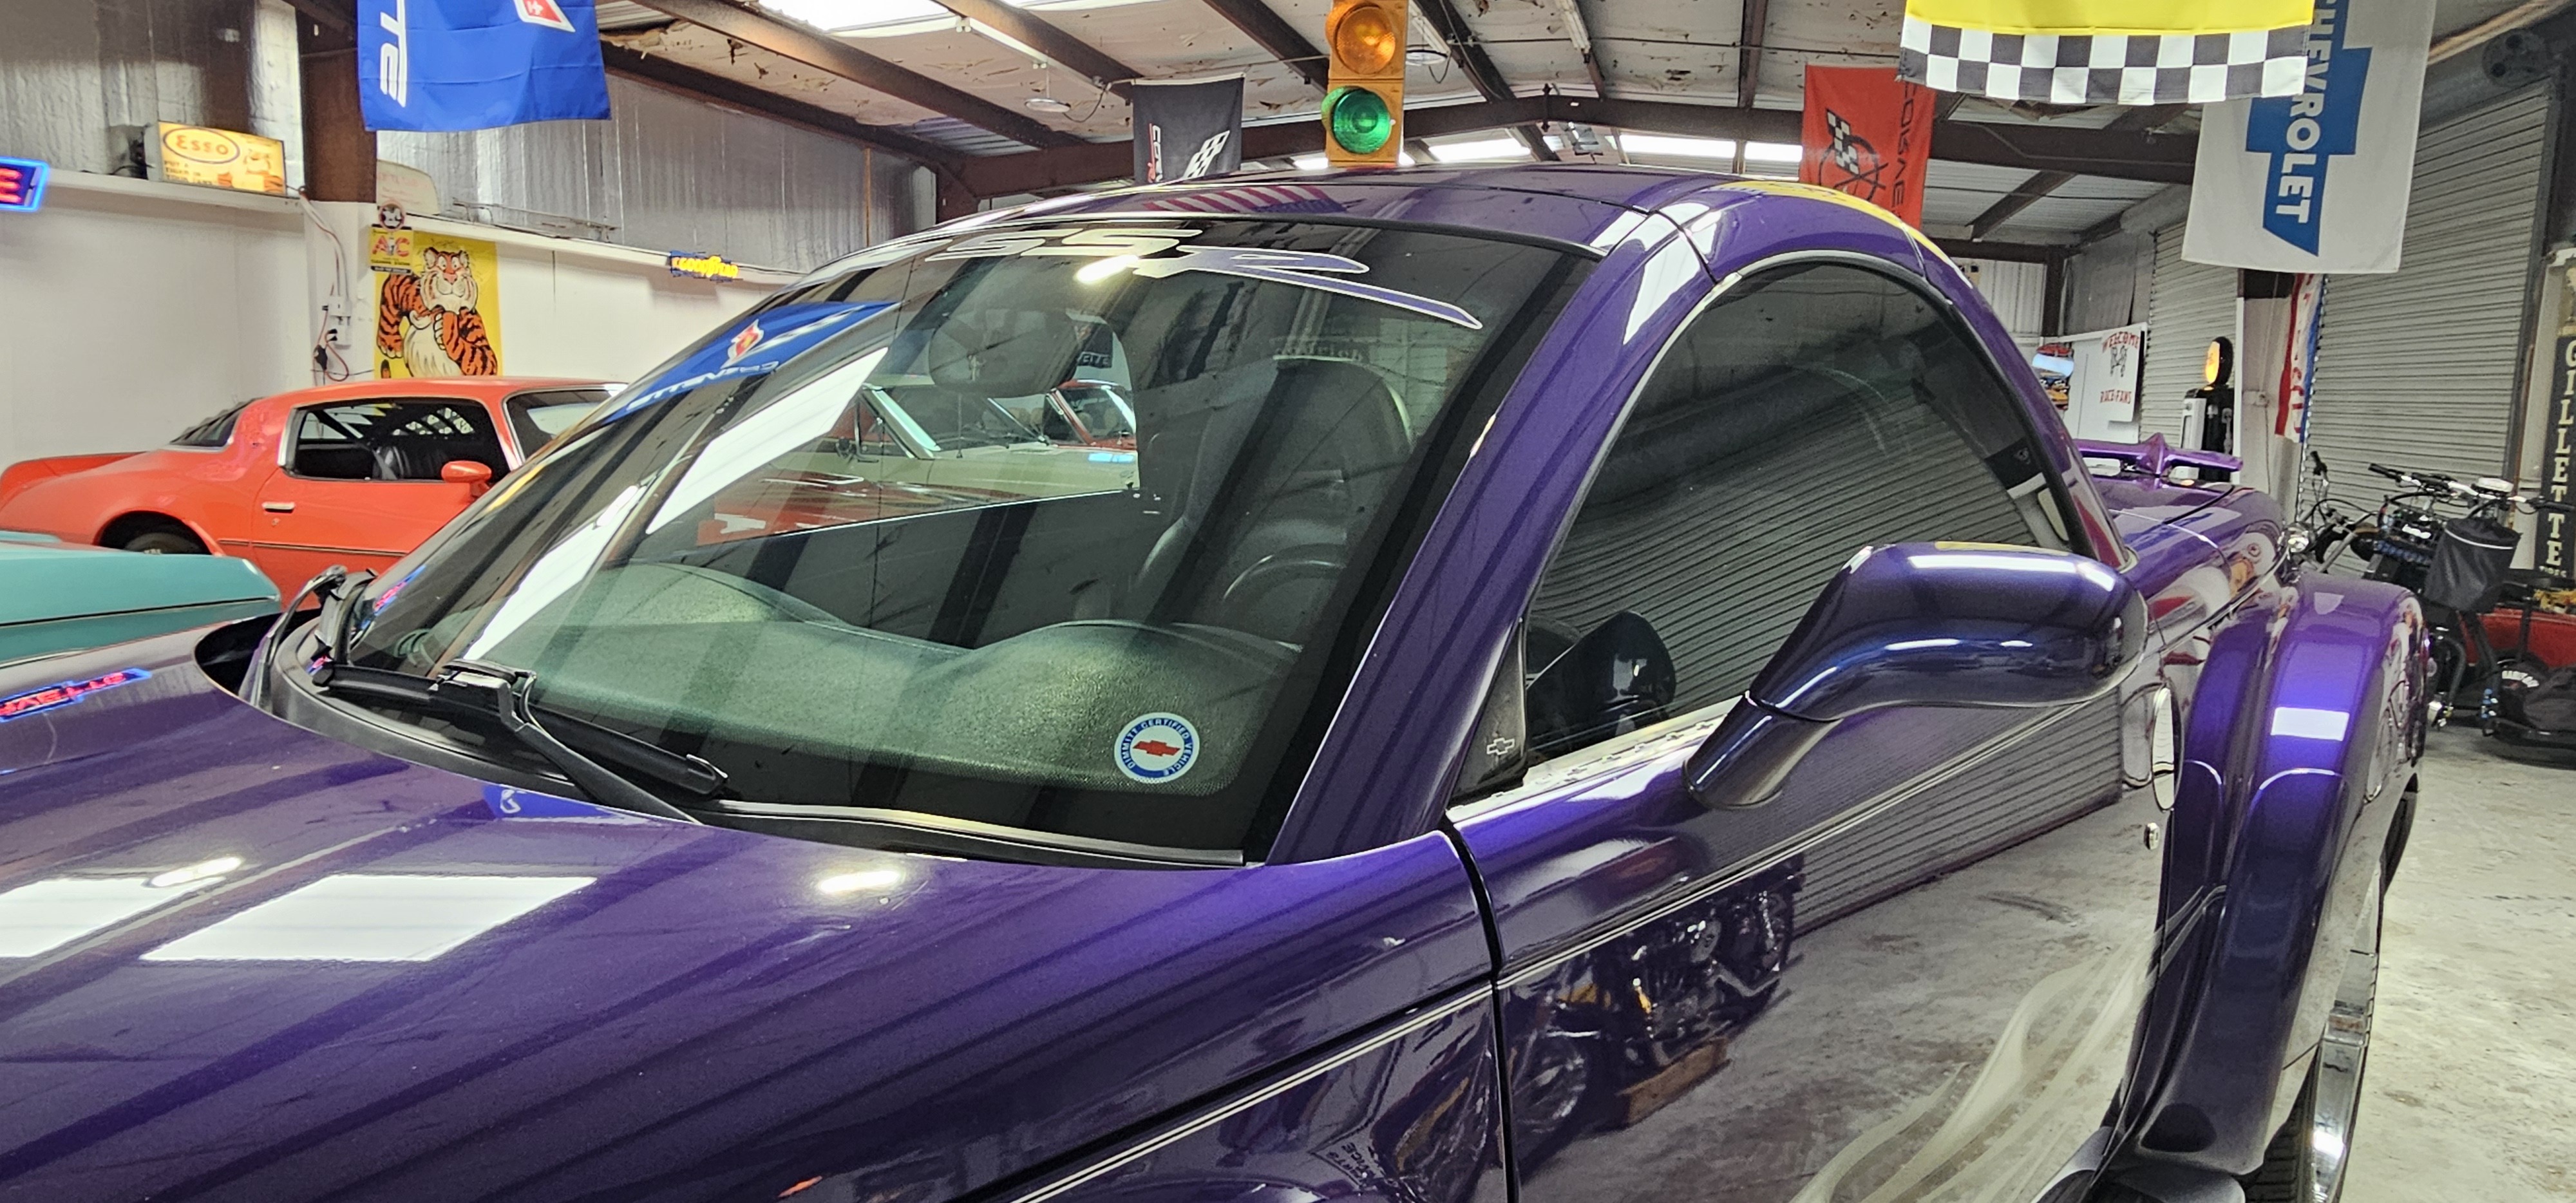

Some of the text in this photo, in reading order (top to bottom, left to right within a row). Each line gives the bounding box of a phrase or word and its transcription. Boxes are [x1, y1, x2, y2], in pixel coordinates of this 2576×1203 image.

[2276, 0, 2337, 223] HEVROLET
[372, 235, 410, 257] AC
[2101, 331, 2141, 353] WELCOME
[2100, 390, 2132, 404] RACE FANS
[1121, 718, 1193, 776] DIMMITT CERTIFIED VEHICLE
